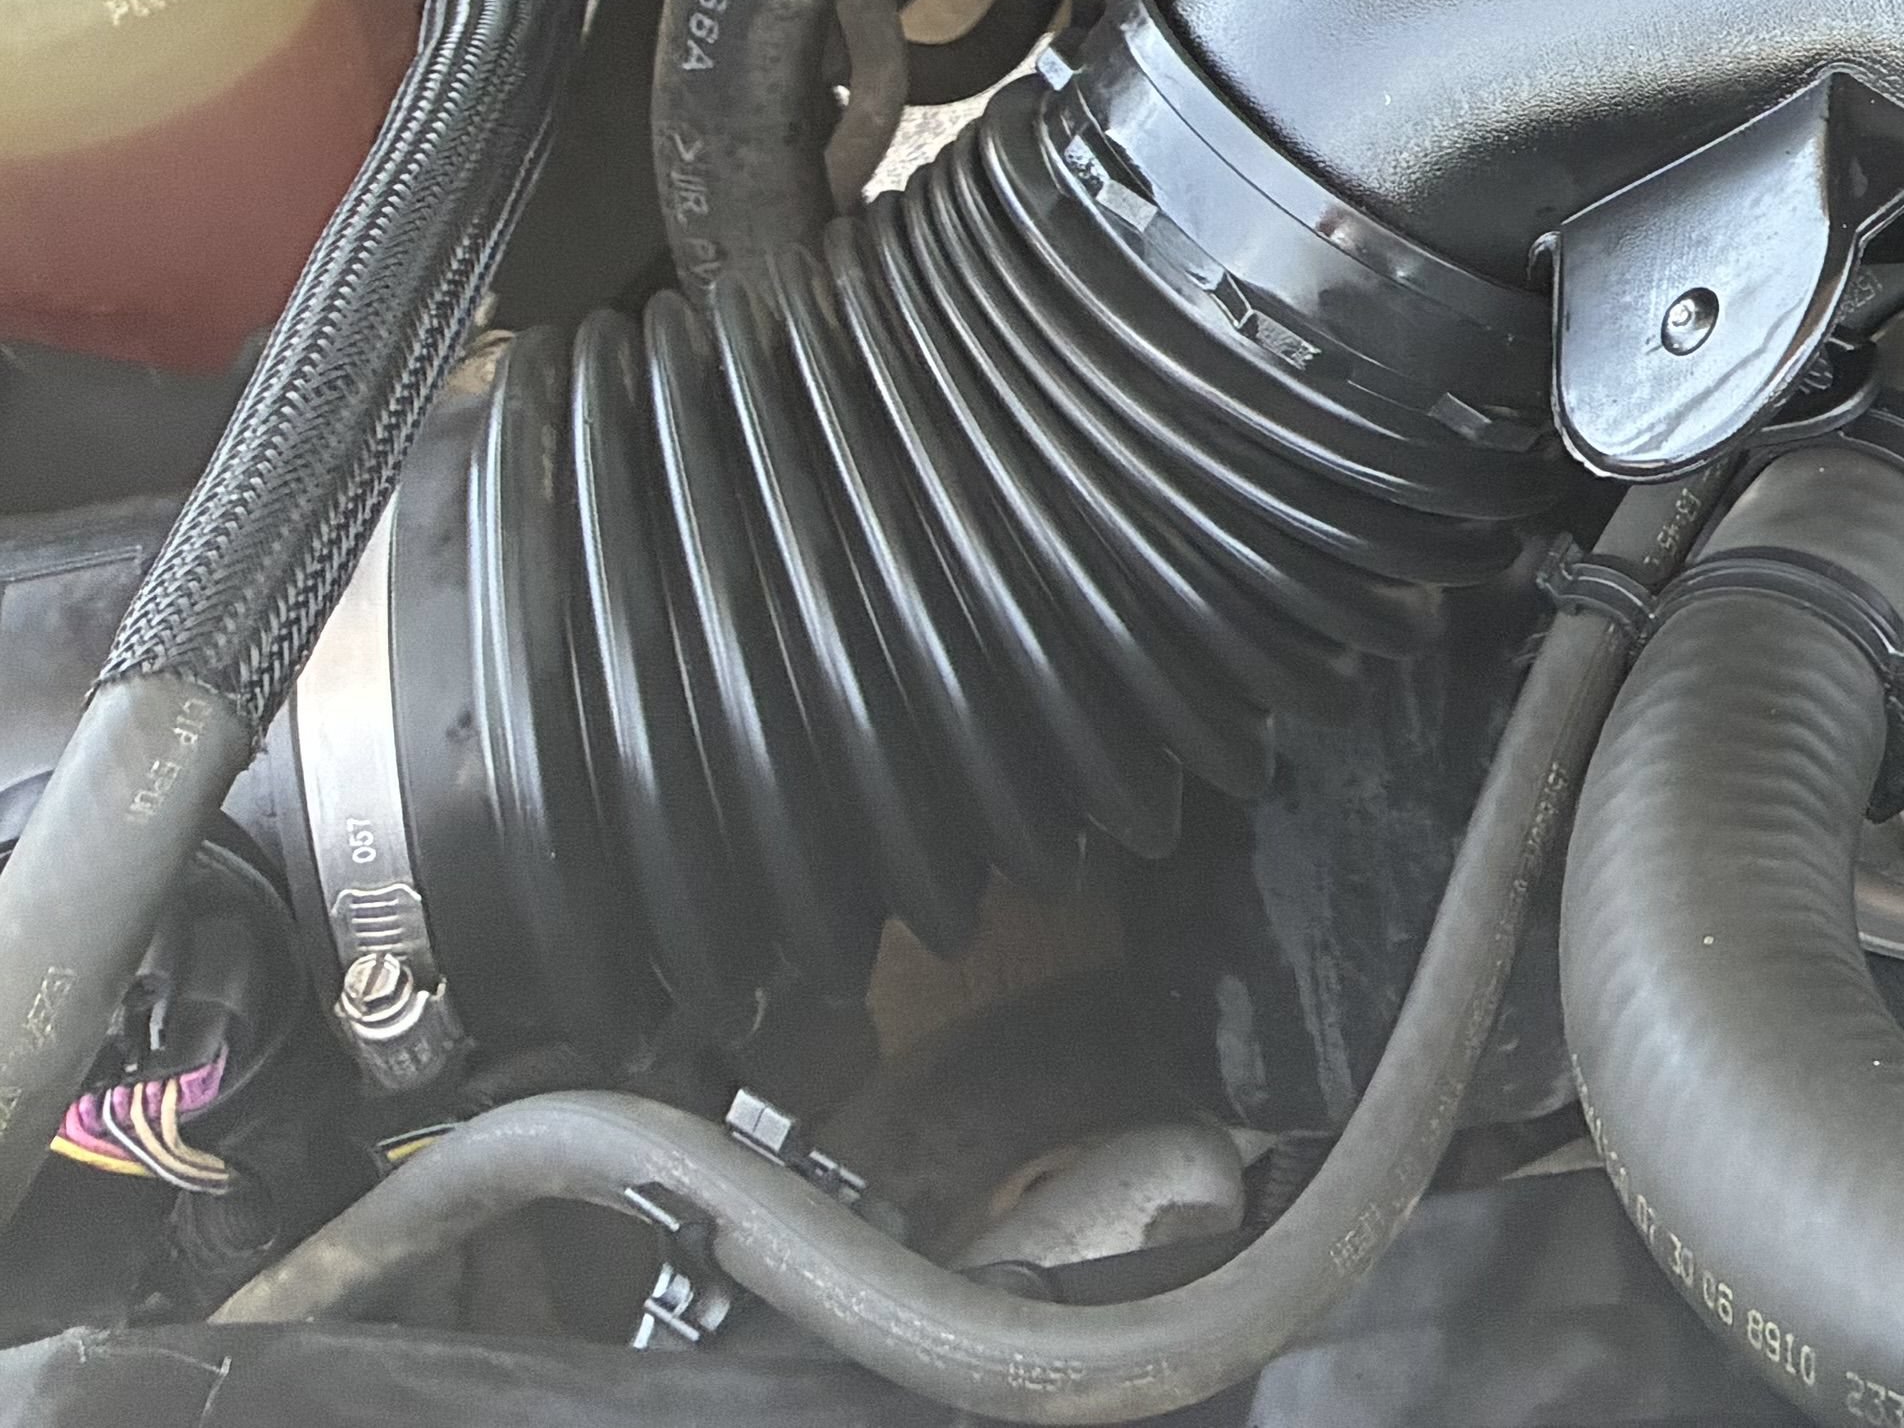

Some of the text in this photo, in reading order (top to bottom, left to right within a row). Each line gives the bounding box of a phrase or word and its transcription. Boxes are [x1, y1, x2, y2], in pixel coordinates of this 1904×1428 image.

[346, 817, 378, 865] 057
[1666, 1233, 1695, 1289] 30
[1702, 1270, 1735, 1327] 06
[1746, 1308, 1818, 1387] 8910
